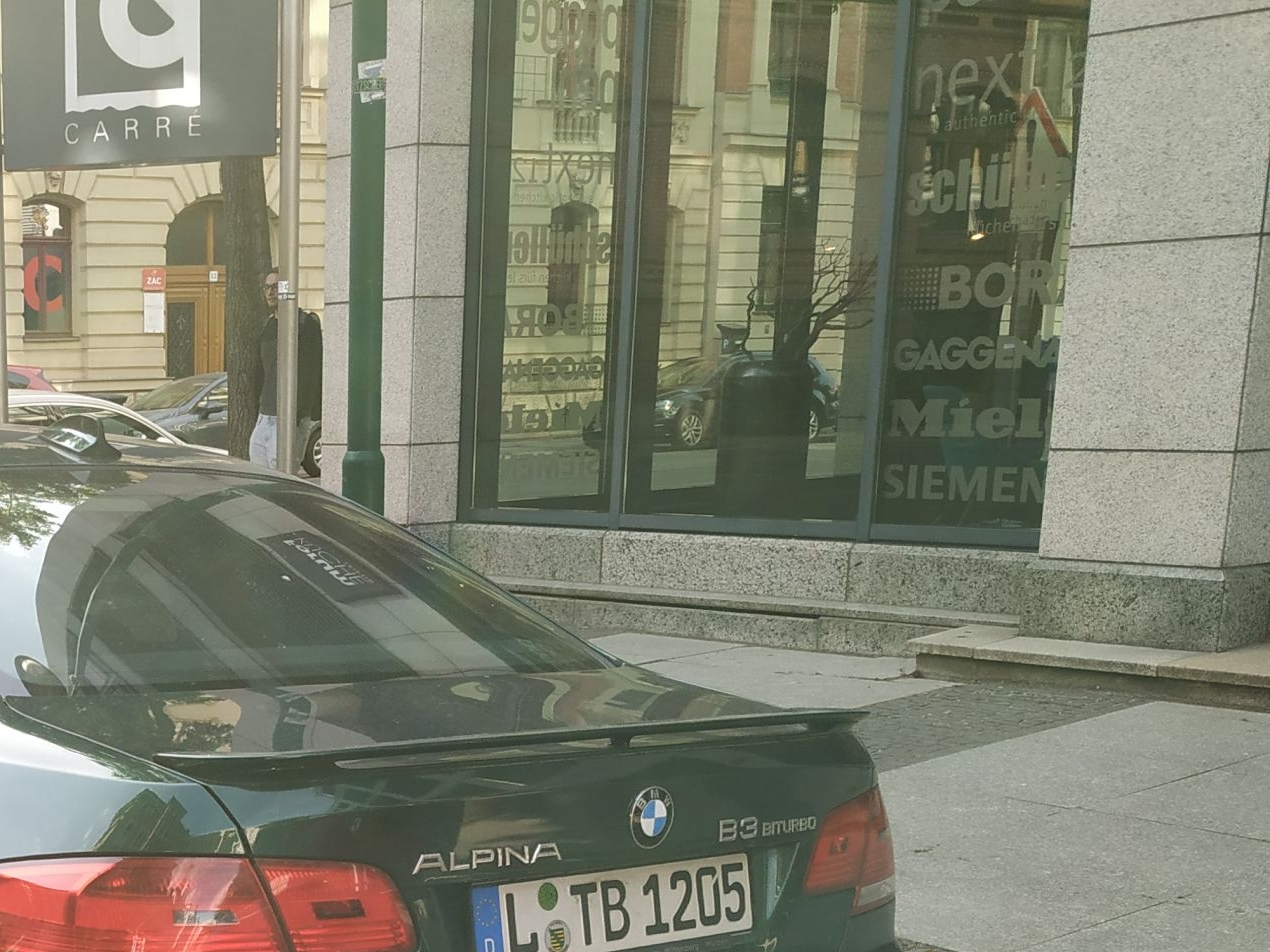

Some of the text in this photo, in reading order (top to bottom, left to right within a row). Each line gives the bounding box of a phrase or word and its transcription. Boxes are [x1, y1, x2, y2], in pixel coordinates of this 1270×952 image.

[65, 108, 202, 145] CARRÉ
[146, 277, 162, 285] ZAC
[938, 259, 1065, 310] BOR
[889, 397, 1050, 439] Miel
[718, 816, 817, 843] B3 BITURBO
[411, 842, 562, 875] ALPINA
[569, 879, 631, 946] TB
[643, 862, 747, 936] 1205
